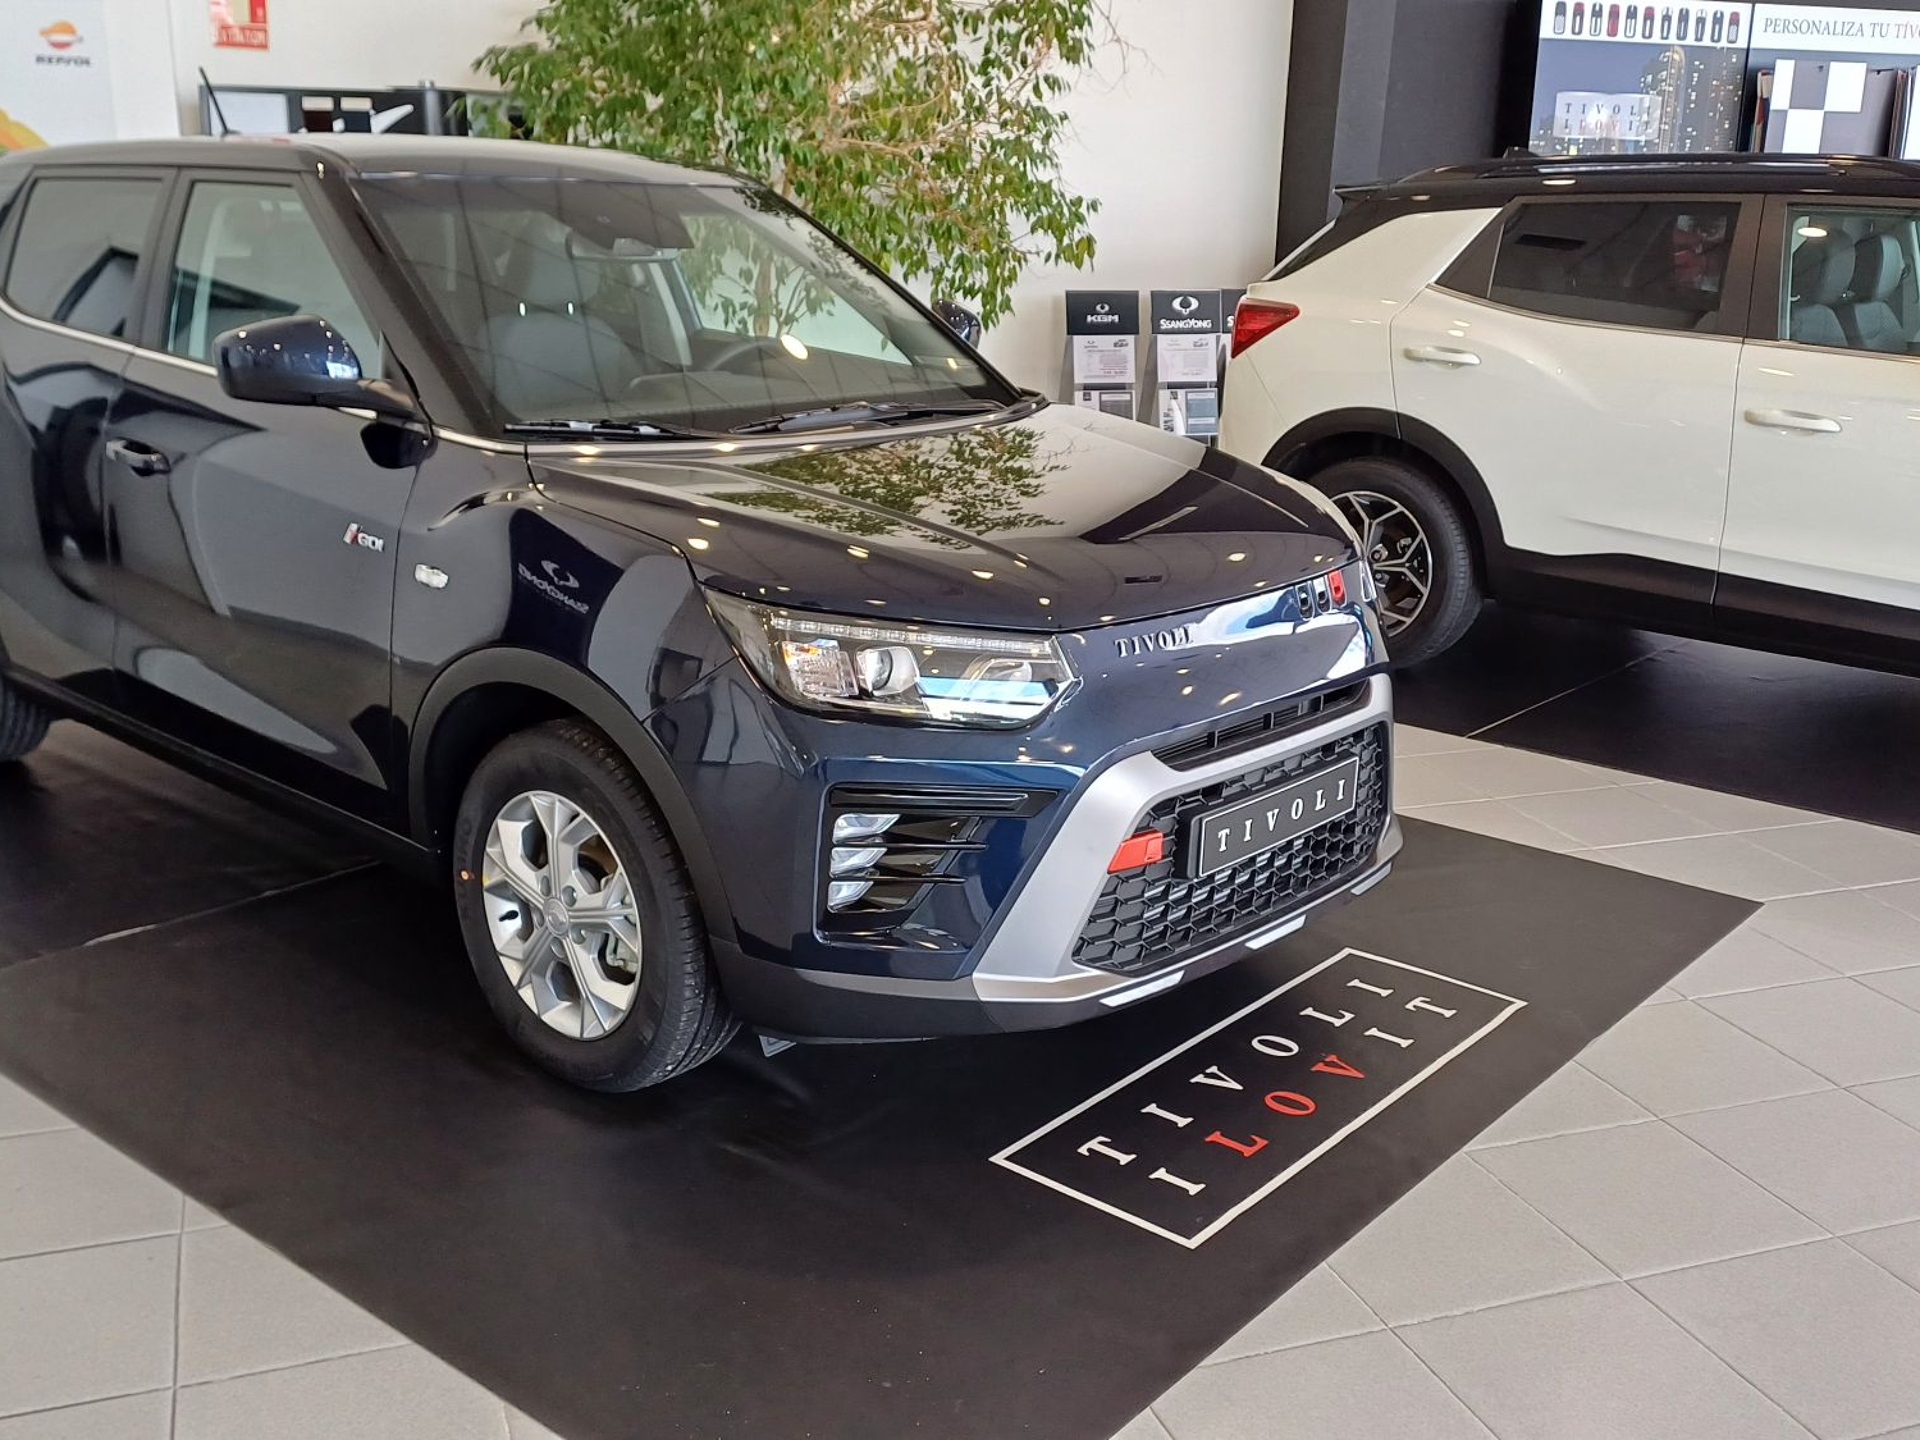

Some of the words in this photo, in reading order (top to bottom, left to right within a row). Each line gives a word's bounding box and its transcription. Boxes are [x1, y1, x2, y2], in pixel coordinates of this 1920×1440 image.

[1763, 17, 1865, 38] PERSONALIZA
[1869, 22, 1890, 38] TU
[1564, 102, 1652, 117] TIVOLI
[1086, 314, 1120, 324] KGM
[1113, 622, 1195, 659] TIVOLI
[1217, 778, 1346, 853] TIVOLI
[1077, 977, 1394, 1166] TIVOLI
